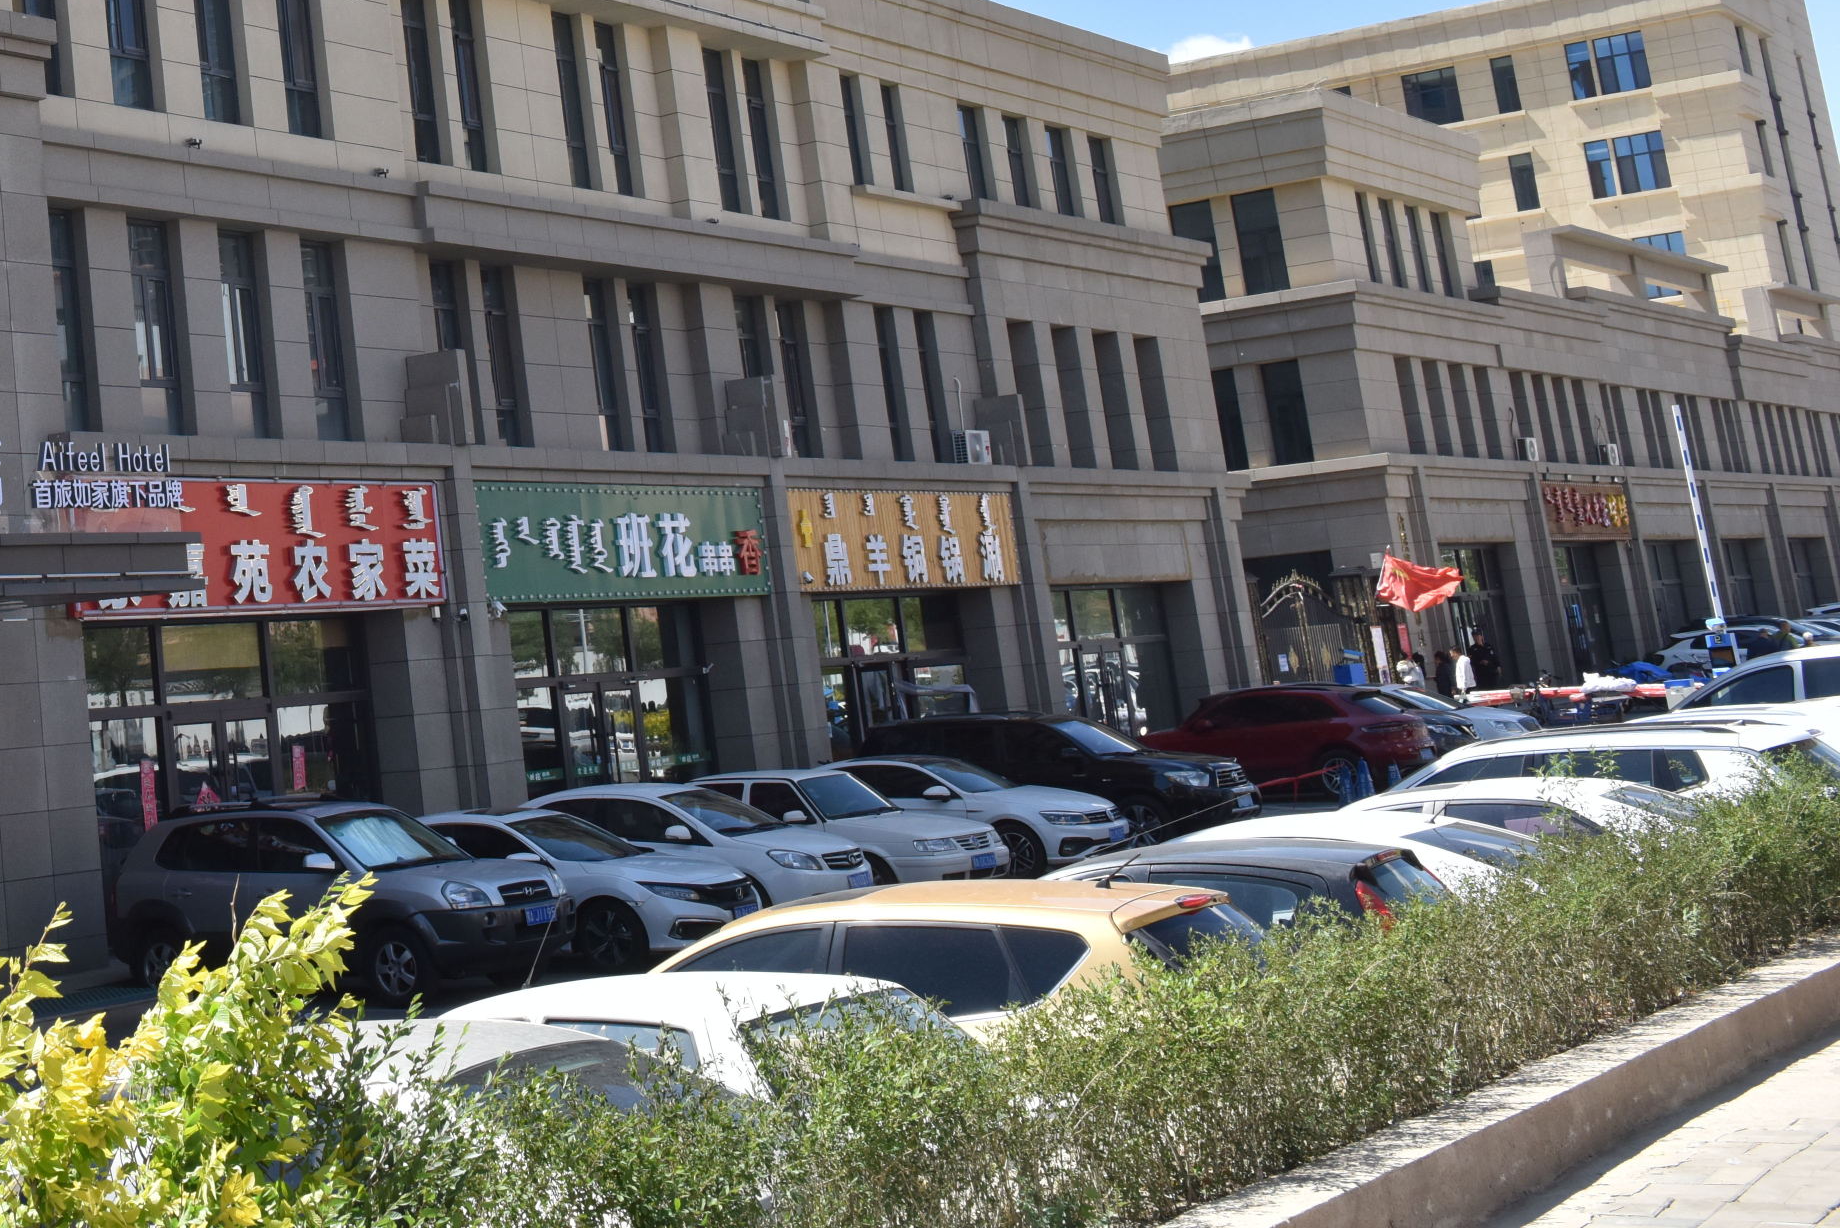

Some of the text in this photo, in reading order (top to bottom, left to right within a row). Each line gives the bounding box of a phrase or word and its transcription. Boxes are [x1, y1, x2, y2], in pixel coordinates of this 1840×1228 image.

[40, 440, 171, 473] Aifeel Hotel
[32, 478, 185, 509] 首旅如家旗下品牌
[98, 537, 443, 609] 苑农家菜
